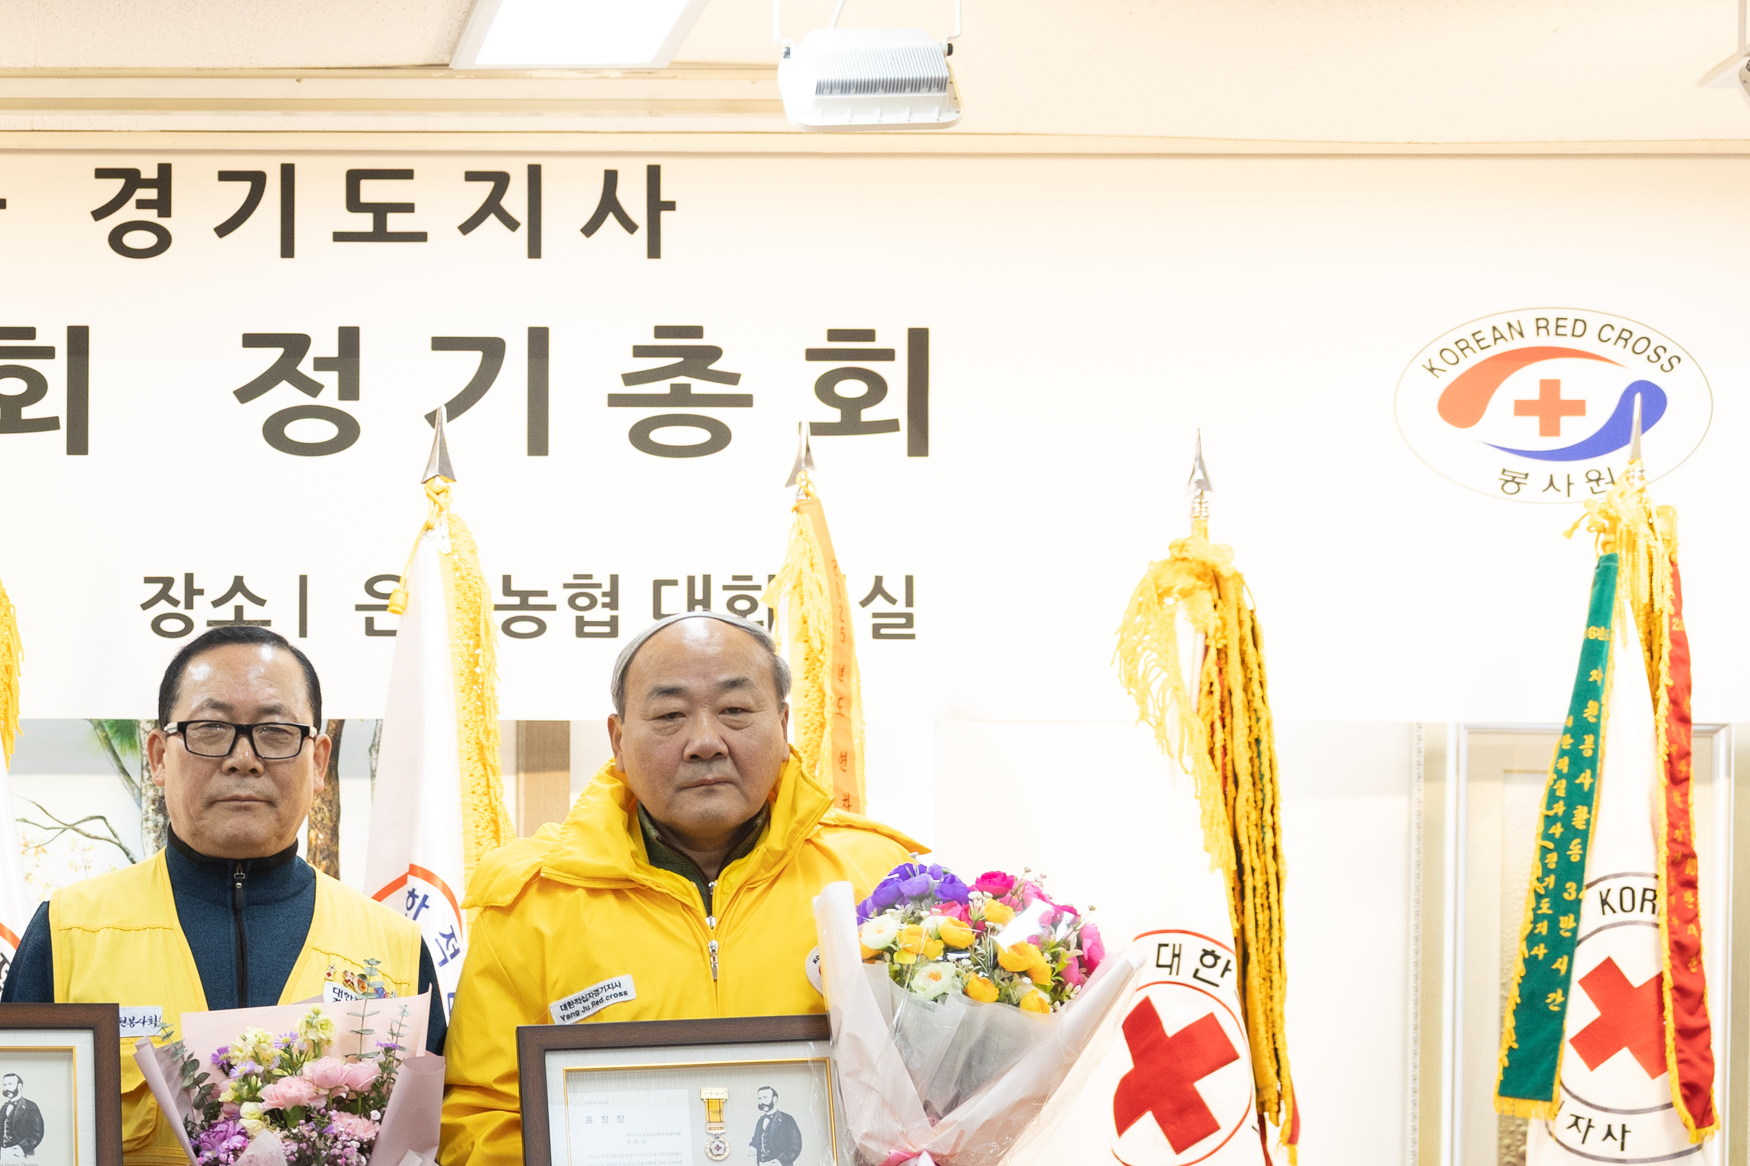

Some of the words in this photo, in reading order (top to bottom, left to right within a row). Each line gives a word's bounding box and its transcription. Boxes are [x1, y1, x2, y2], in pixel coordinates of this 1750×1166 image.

[89, 163, 677, 259] 경기도지사
[1422, 320, 1525, 379] KOREAN
[1535, 317, 1587, 338] RED
[1597, 323, 1682, 374] CROSS
[232, 325, 930, 458] 정기총회
[1498, 467, 1616, 498] 봉사원
[354, 573, 619, 640] 은농협
[560, 1009, 580, 1022] Yang
[581, 1005, 591, 1013] Ju
[591, 998, 604, 1008] Red
[605, 990, 629, 1001] cross
[1554, 1100, 1632, 1152] 자사
